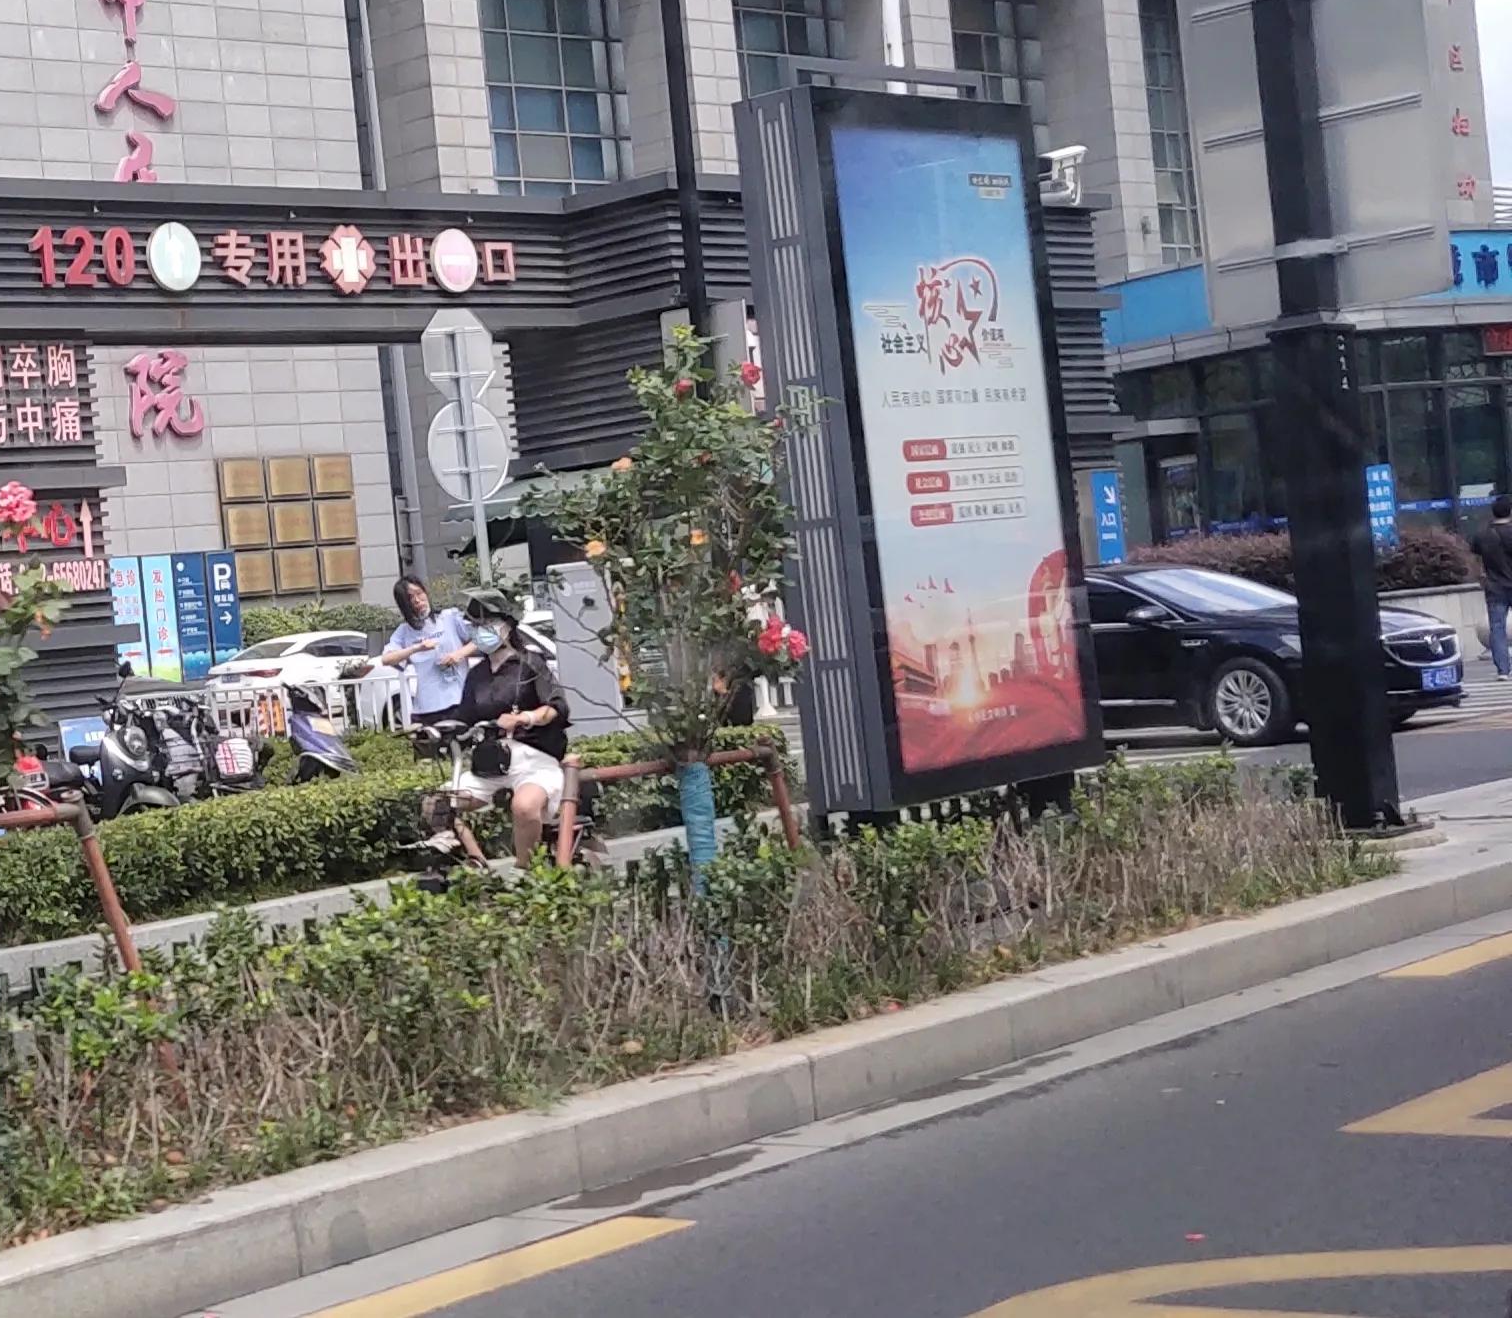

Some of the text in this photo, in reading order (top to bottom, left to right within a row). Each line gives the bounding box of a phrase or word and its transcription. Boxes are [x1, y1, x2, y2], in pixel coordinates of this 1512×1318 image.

[28, 225, 516, 287] 120 专用 出口
[124, 348, 205, 439] 院
